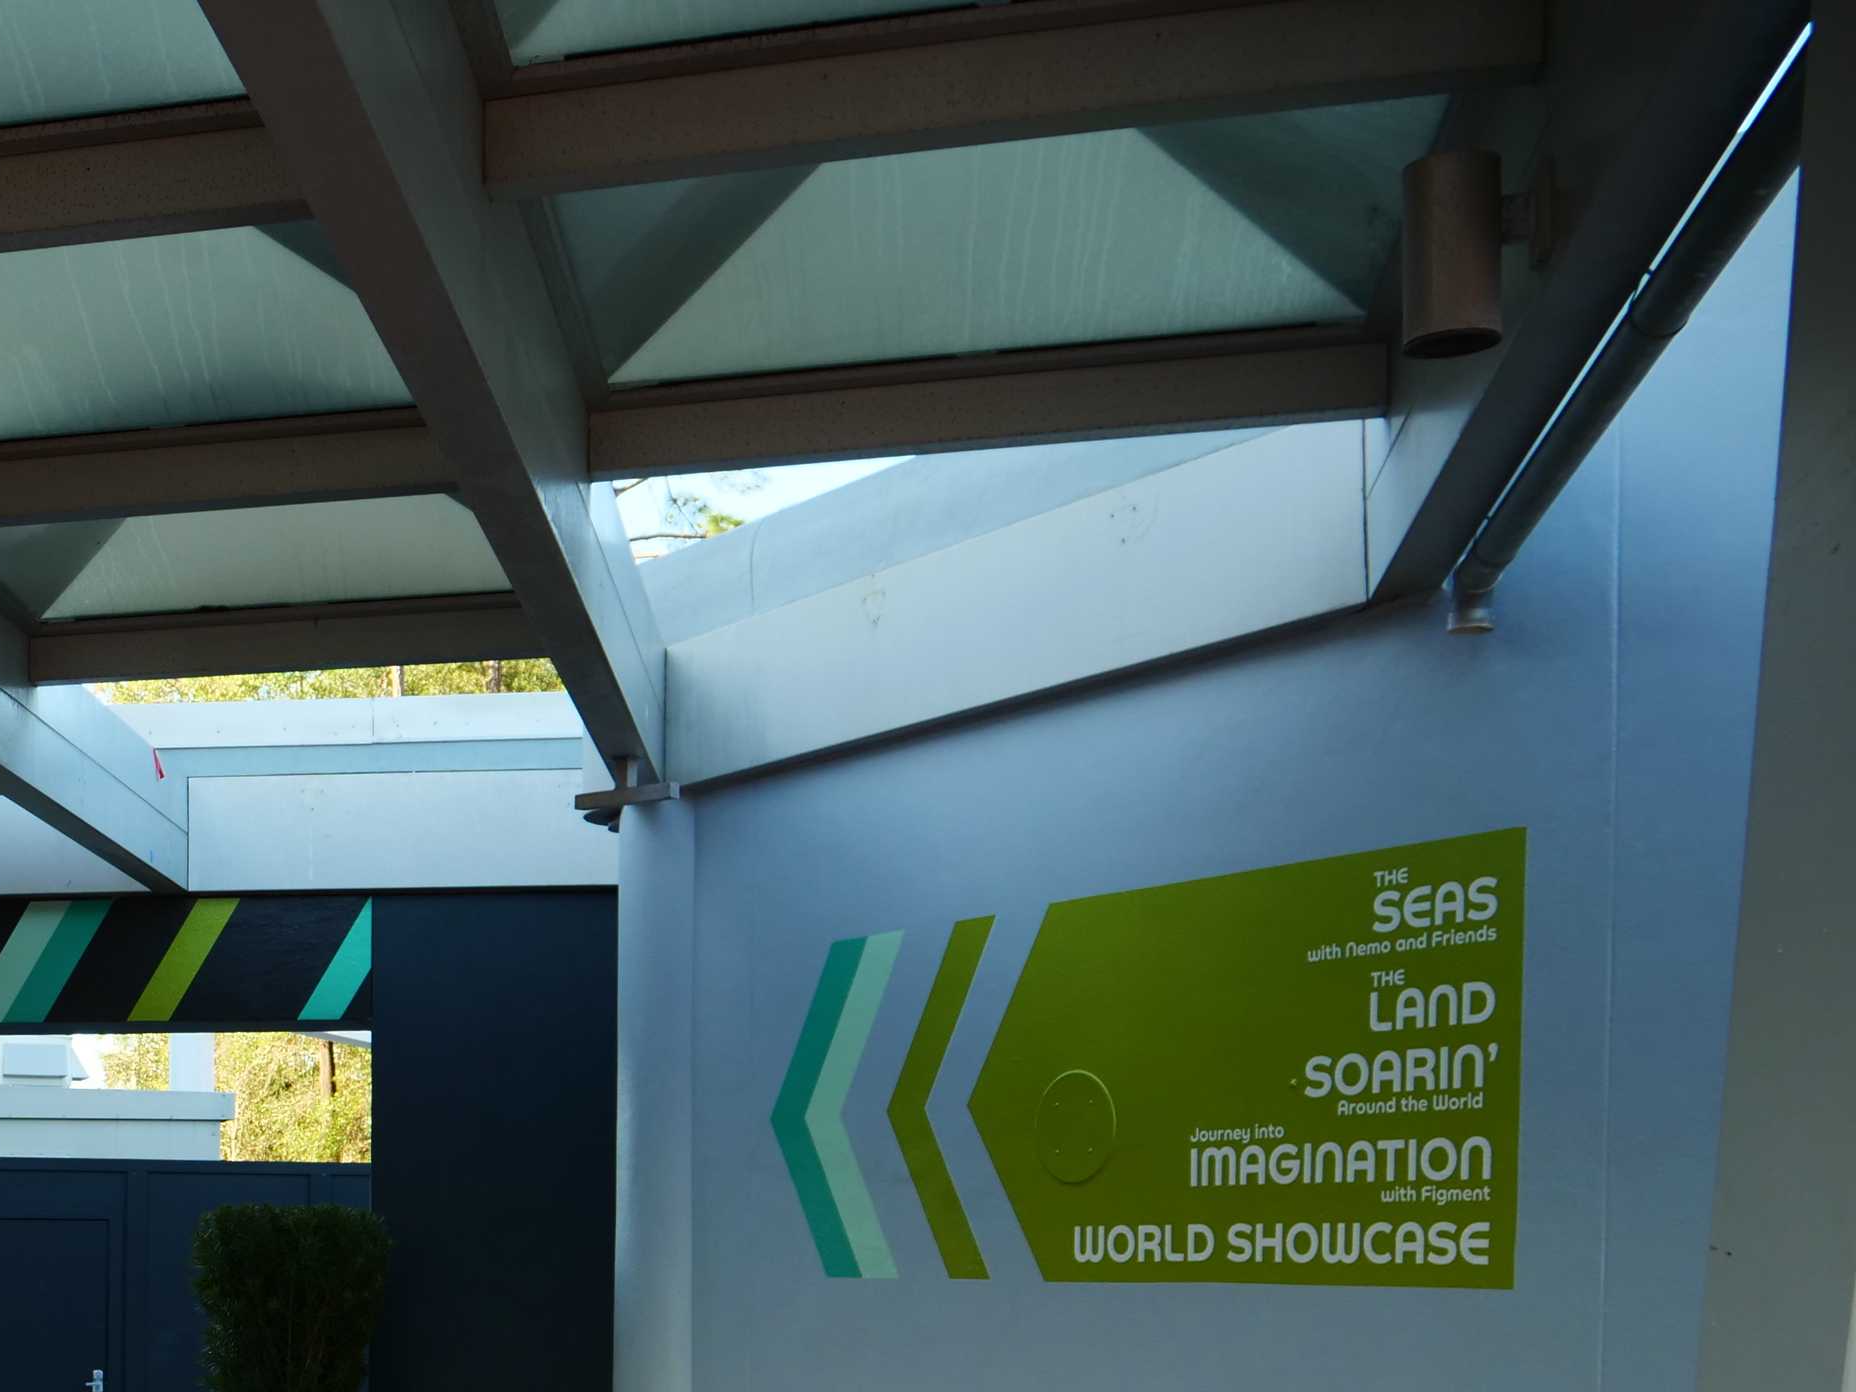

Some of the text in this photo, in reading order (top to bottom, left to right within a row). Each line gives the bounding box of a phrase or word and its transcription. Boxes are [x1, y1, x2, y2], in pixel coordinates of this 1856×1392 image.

[1374, 867, 1409, 887] THE
[1372, 876, 1499, 933] SEAS
[1307, 925, 1497, 962] with Nemo and Friends
[1370, 969, 1406, 988] THE
[1369, 981, 1497, 1033] LAND
[1304, 1043, 1499, 1098] SOARIN'
[1337, 1092, 1484, 1116] Around the World
[1190, 1124, 1285, 1143] Journey into
[1190, 1136, 1493, 1187] IMAGINATION
[1380, 1186, 1491, 1206] with Figment
[1073, 1221, 1491, 1266] WORLD SHOWCASE
